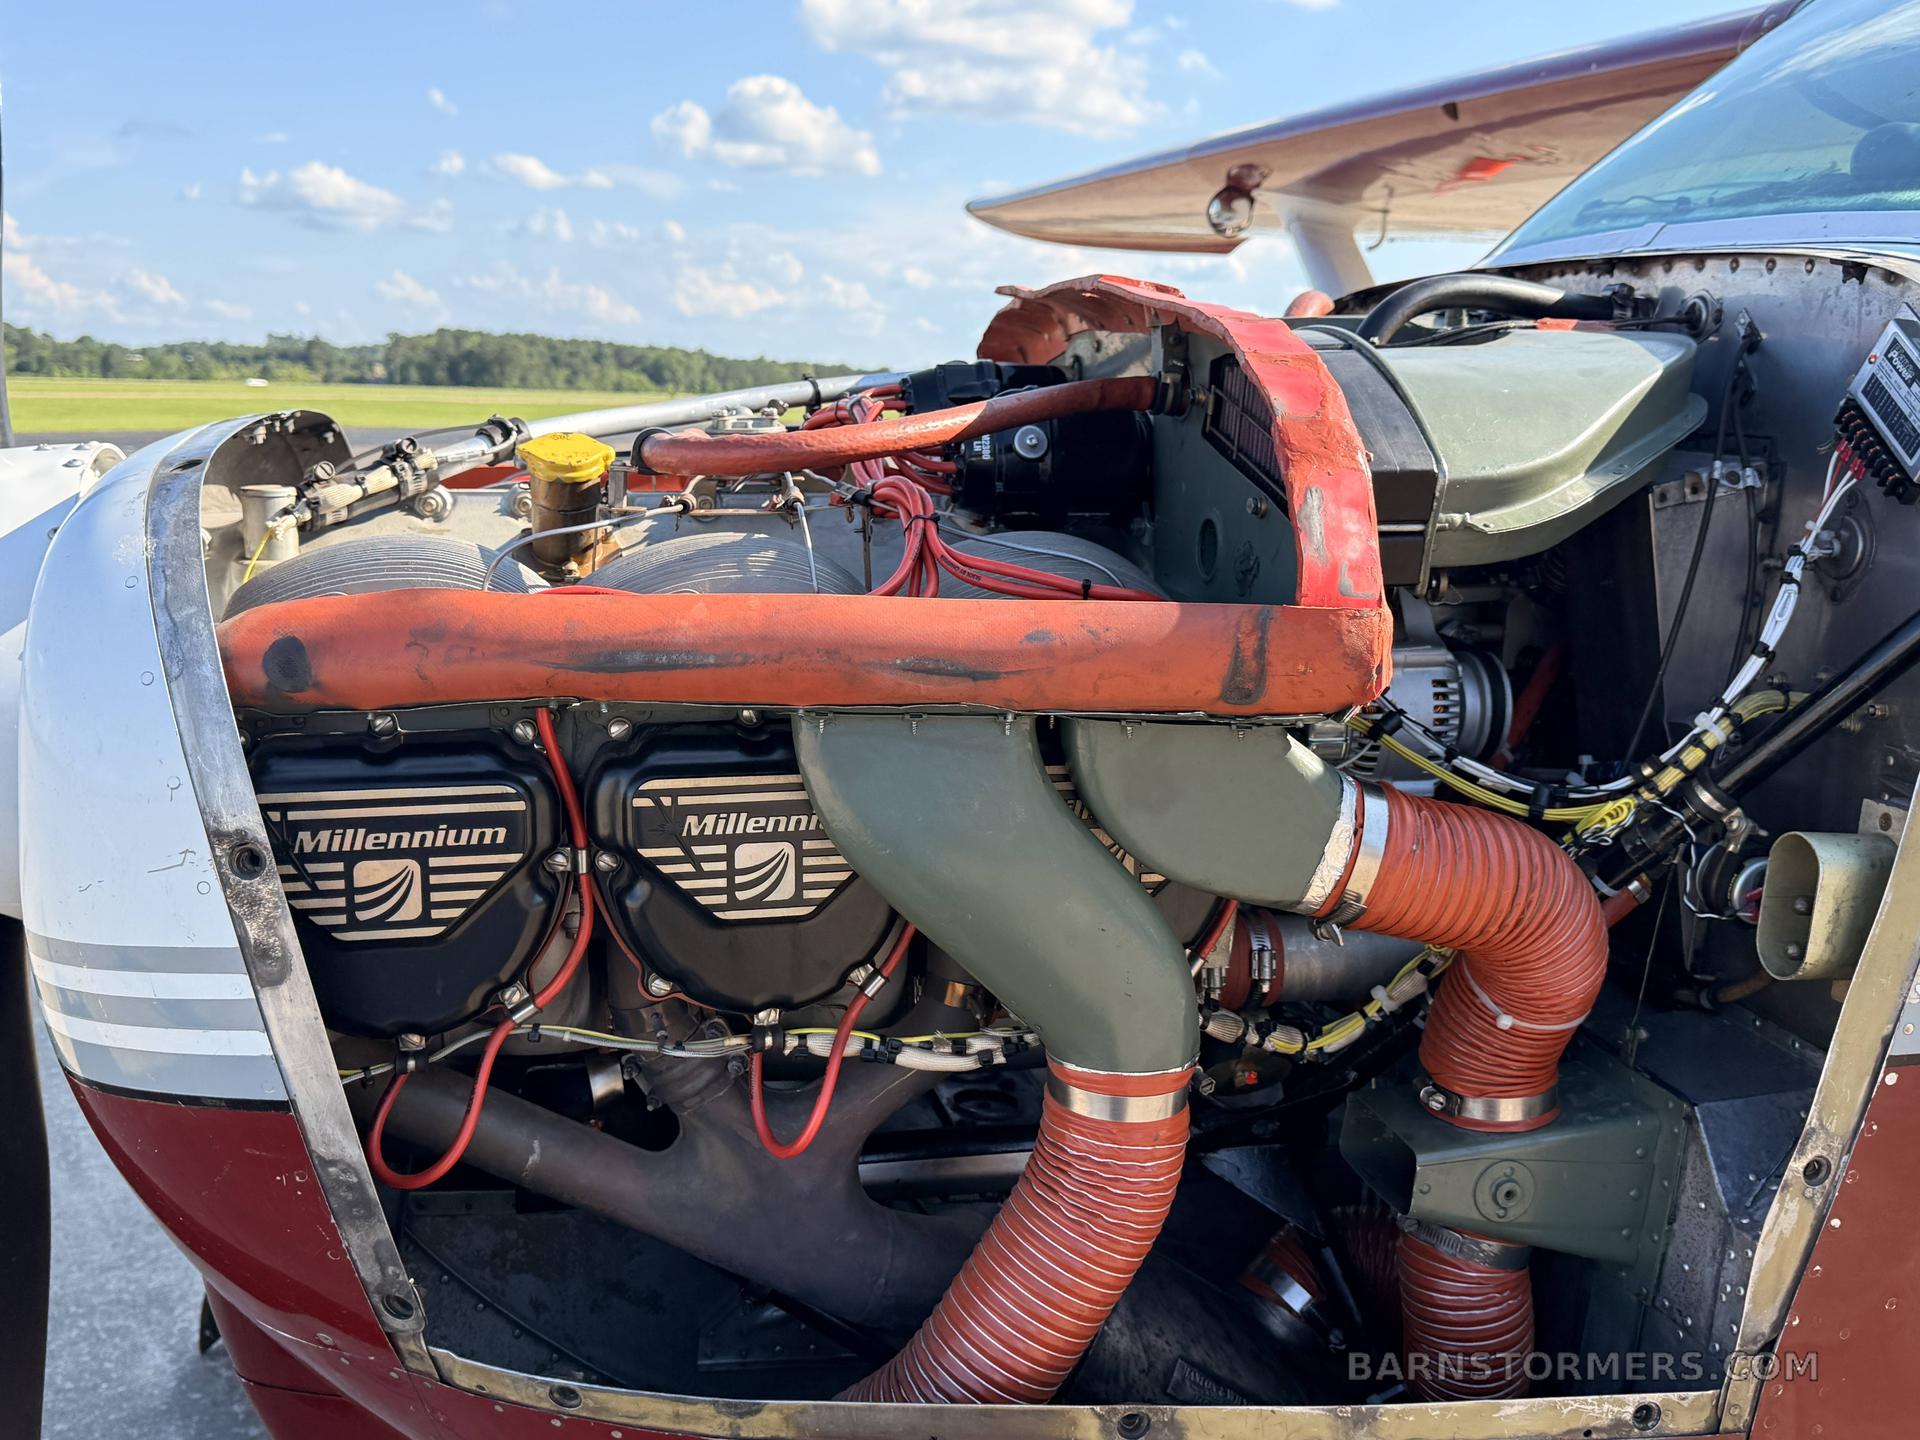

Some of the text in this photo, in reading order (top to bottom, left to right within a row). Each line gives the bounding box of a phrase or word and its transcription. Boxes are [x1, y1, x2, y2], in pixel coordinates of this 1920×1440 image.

[1887, 349, 1913, 381] Power
[682, 811, 825, 837] Millenni
[293, 825, 507, 853] Millennium
